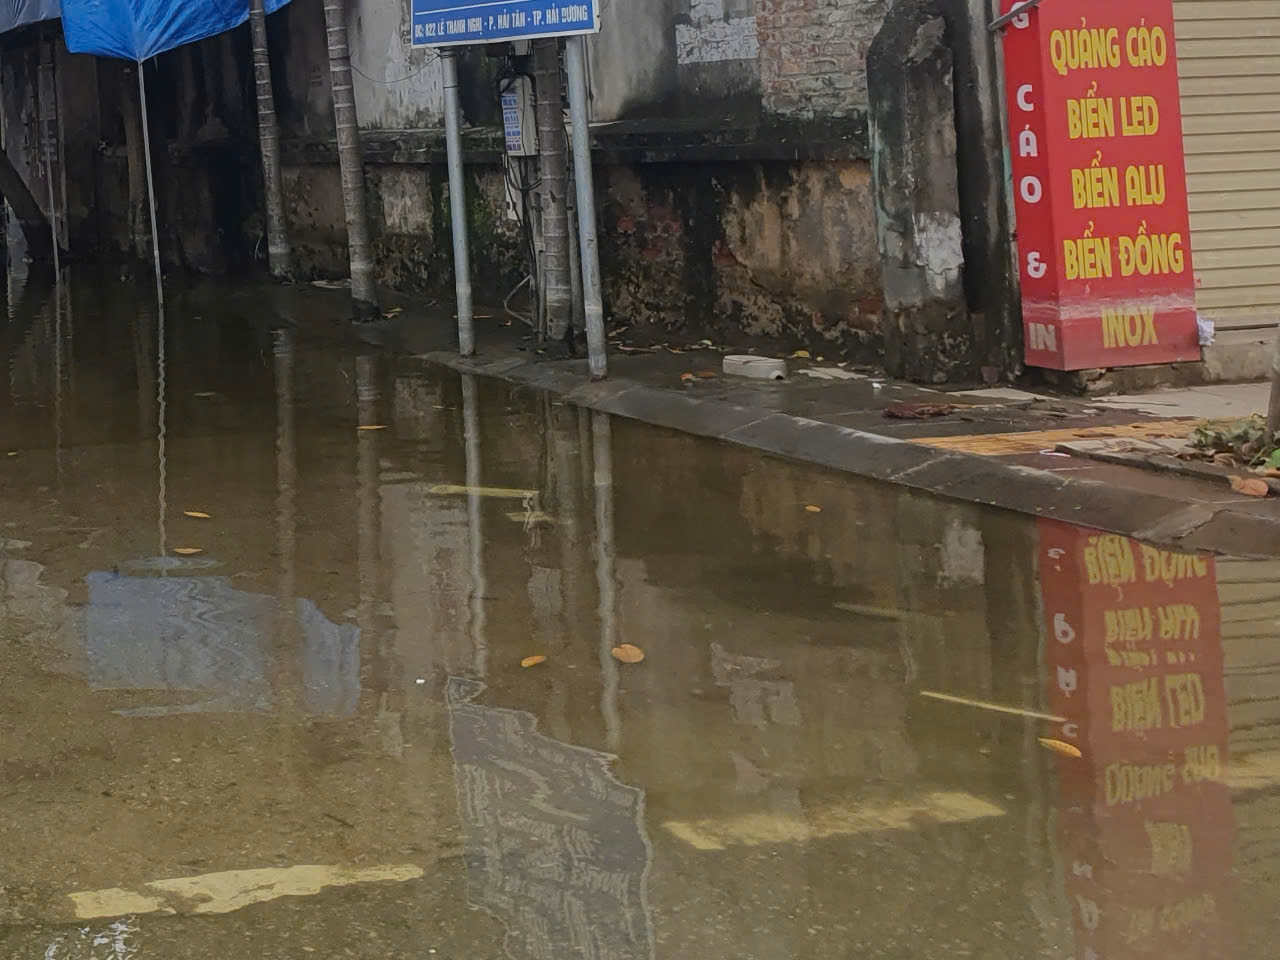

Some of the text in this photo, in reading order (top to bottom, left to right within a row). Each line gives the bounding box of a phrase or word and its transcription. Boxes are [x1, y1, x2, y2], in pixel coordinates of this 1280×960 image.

[1049, 17, 1167, 76] QUẢNG CÁO
[1067, 80, 1160, 139] BIỂN LED
[1071, 150, 1166, 209] BIỂN ALU
[1063, 219, 1184, 281] BIỂN ĐỒNG
[1029, 321, 1058, 353] IN
[1101, 305, 1159, 349] INOX
